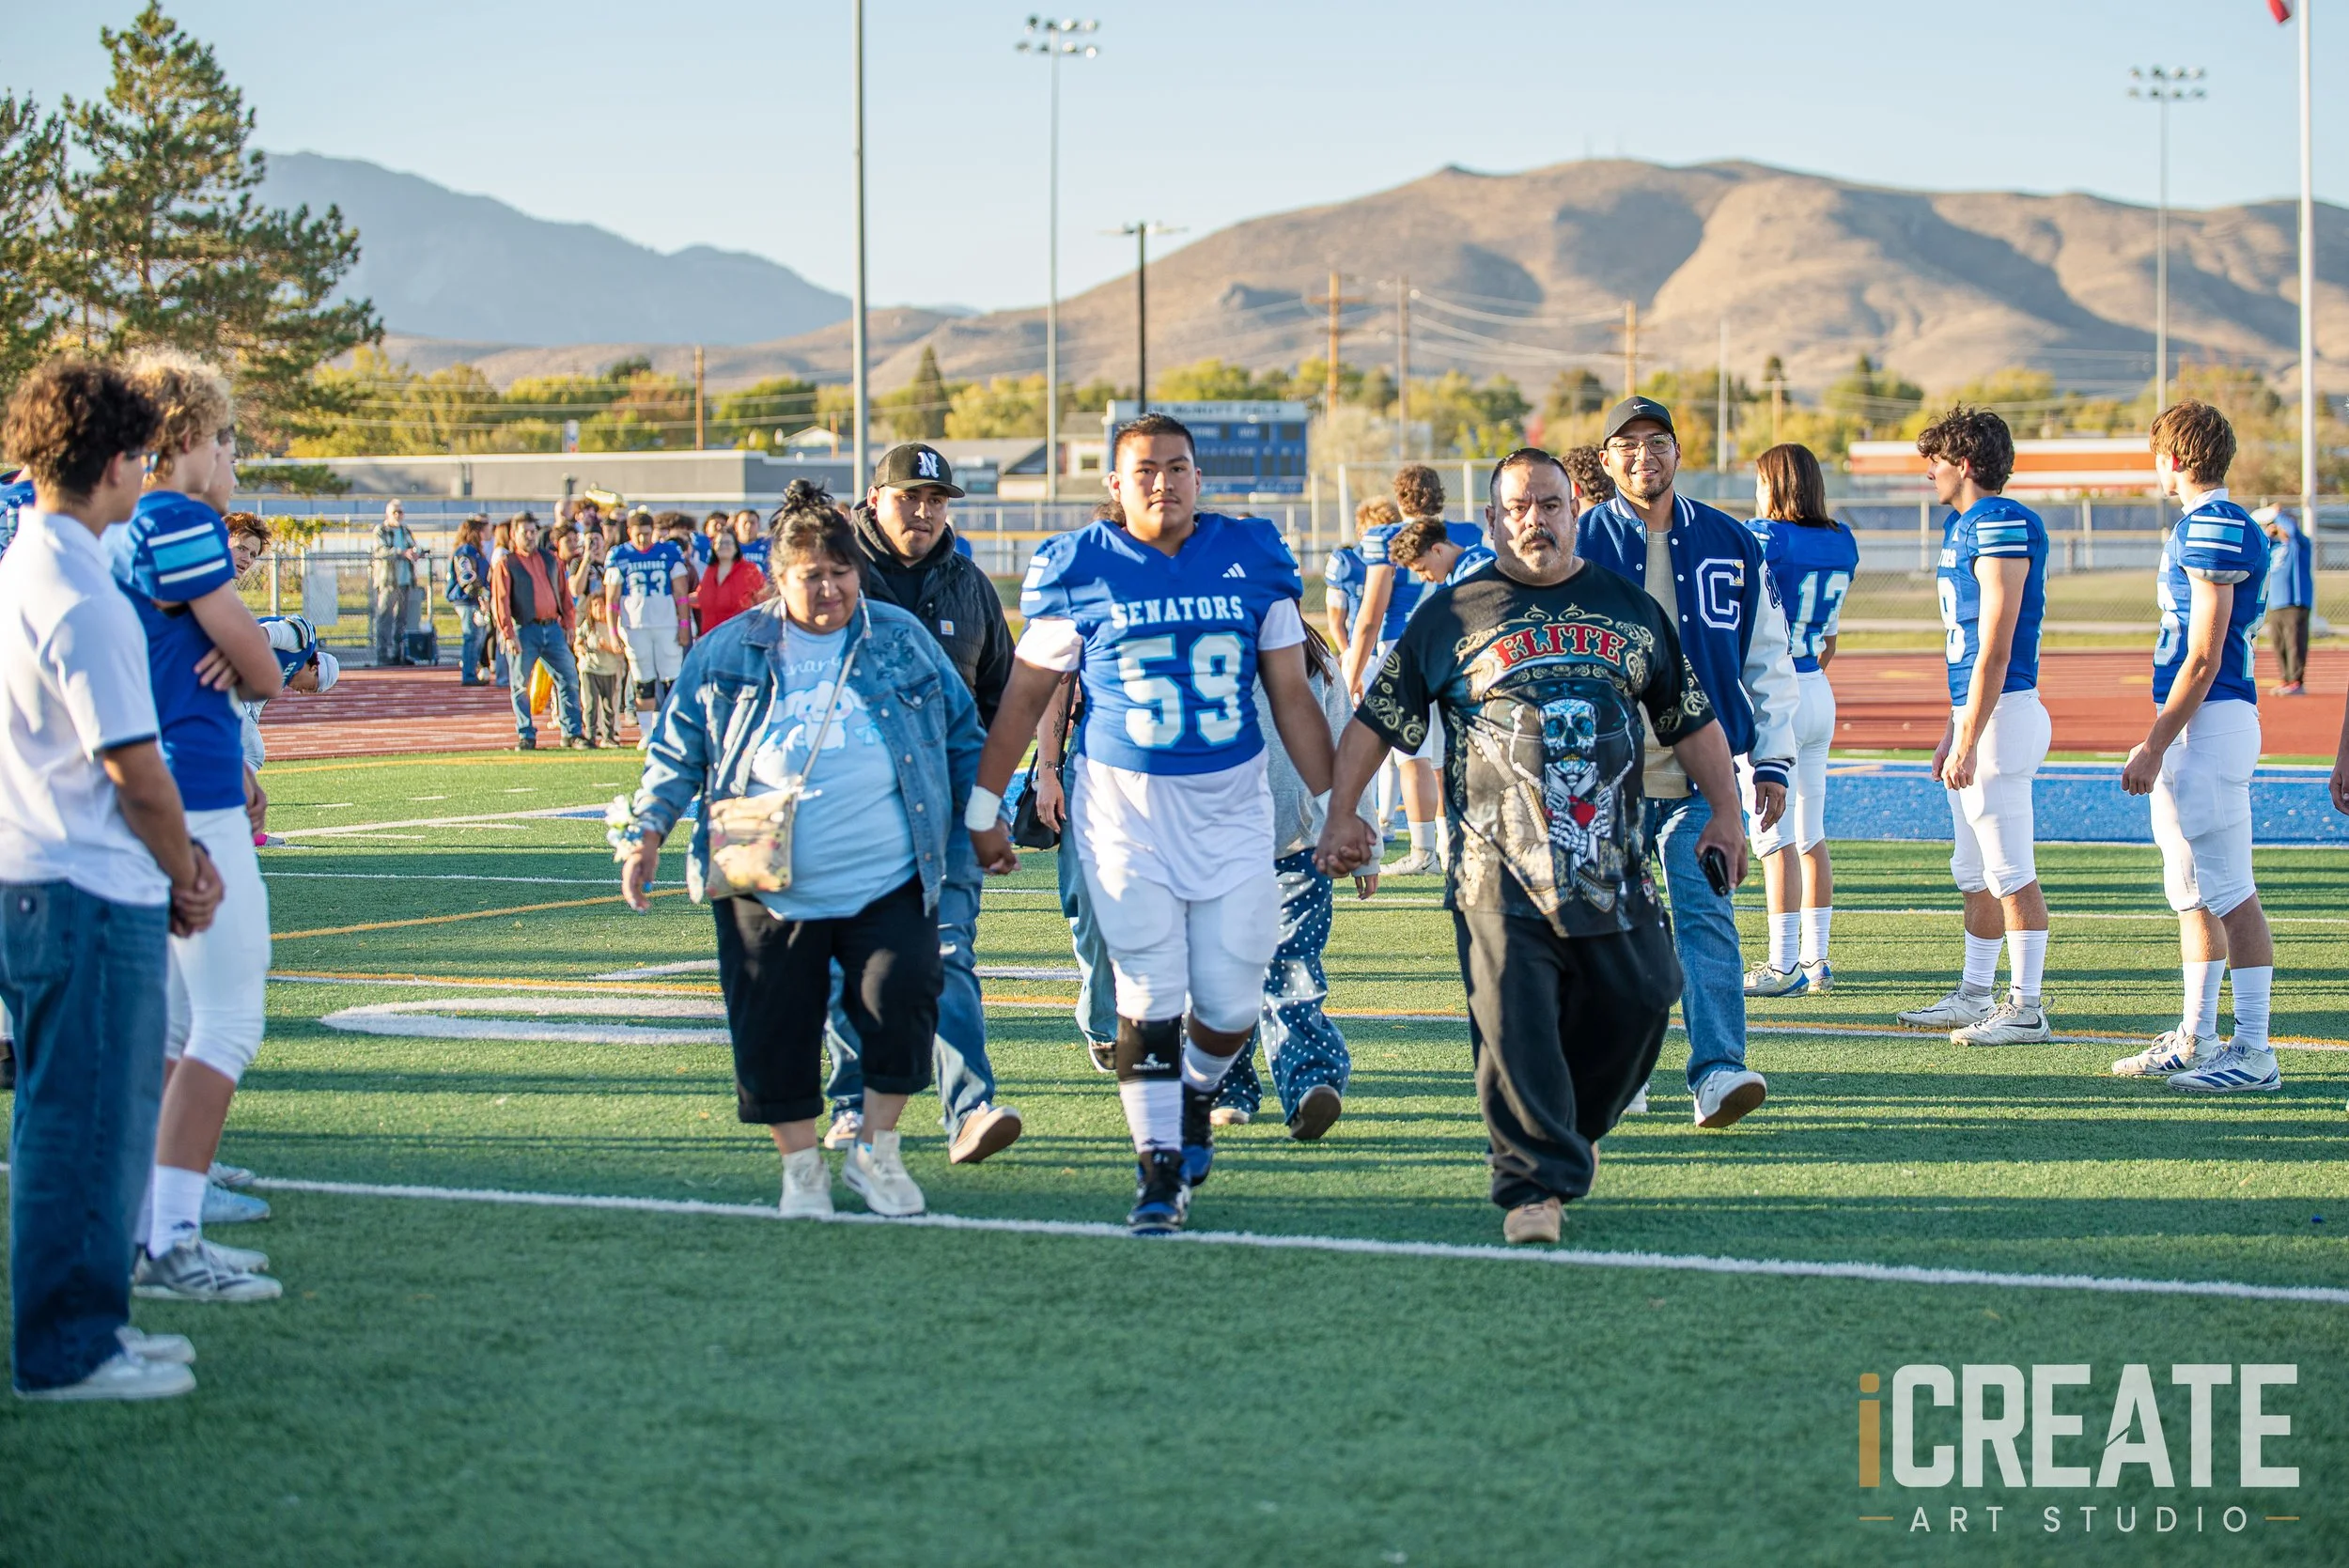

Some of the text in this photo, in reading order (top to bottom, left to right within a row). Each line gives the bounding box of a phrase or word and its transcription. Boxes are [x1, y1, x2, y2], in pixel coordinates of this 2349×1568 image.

[917, 451, 939, 478] N
[1111, 596, 1245, 629] SENATORS
[1695, 558, 1745, 630] C
[1488, 623, 1627, 670] ELITE
[1115, 631, 1246, 749] 59
